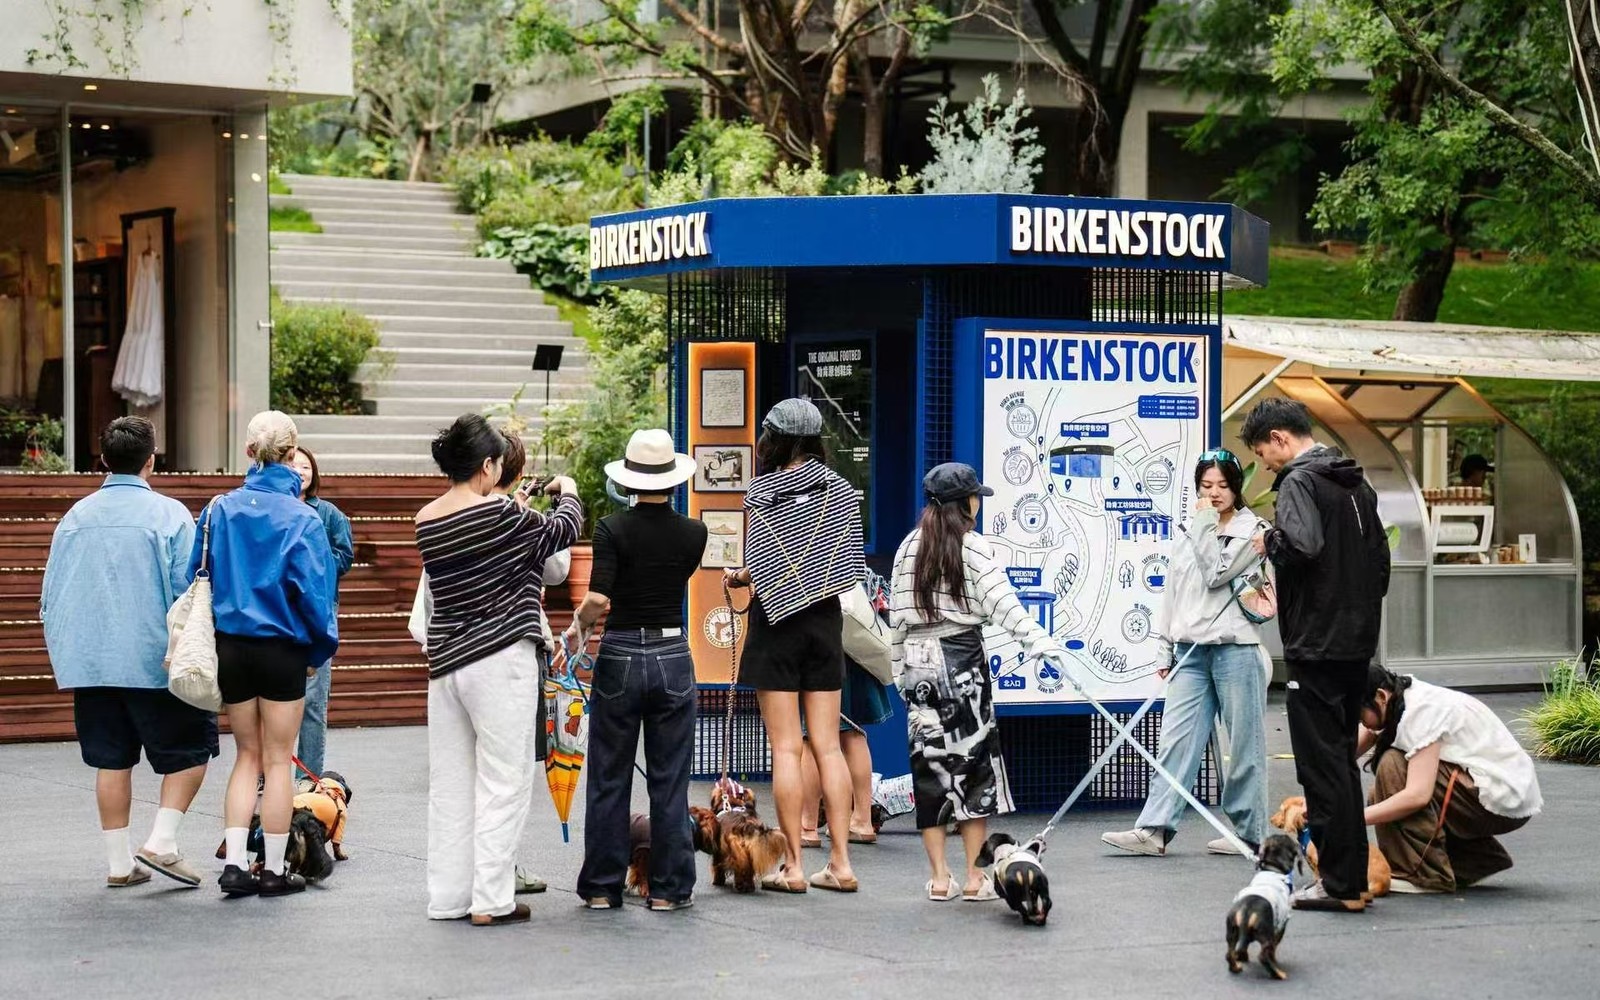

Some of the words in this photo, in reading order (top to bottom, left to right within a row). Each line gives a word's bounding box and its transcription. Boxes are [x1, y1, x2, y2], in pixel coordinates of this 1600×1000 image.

[590, 212, 709, 270] BIRKENSTOCK
[1012, 206, 1225, 258] BIRKENSTOCK
[808, 352, 817, 363] THE
[818, 351, 839, 363] ORIGINAL
[840, 349, 861, 361] FOOTBED
[985, 337, 1197, 383] BIRKENSTOCK
